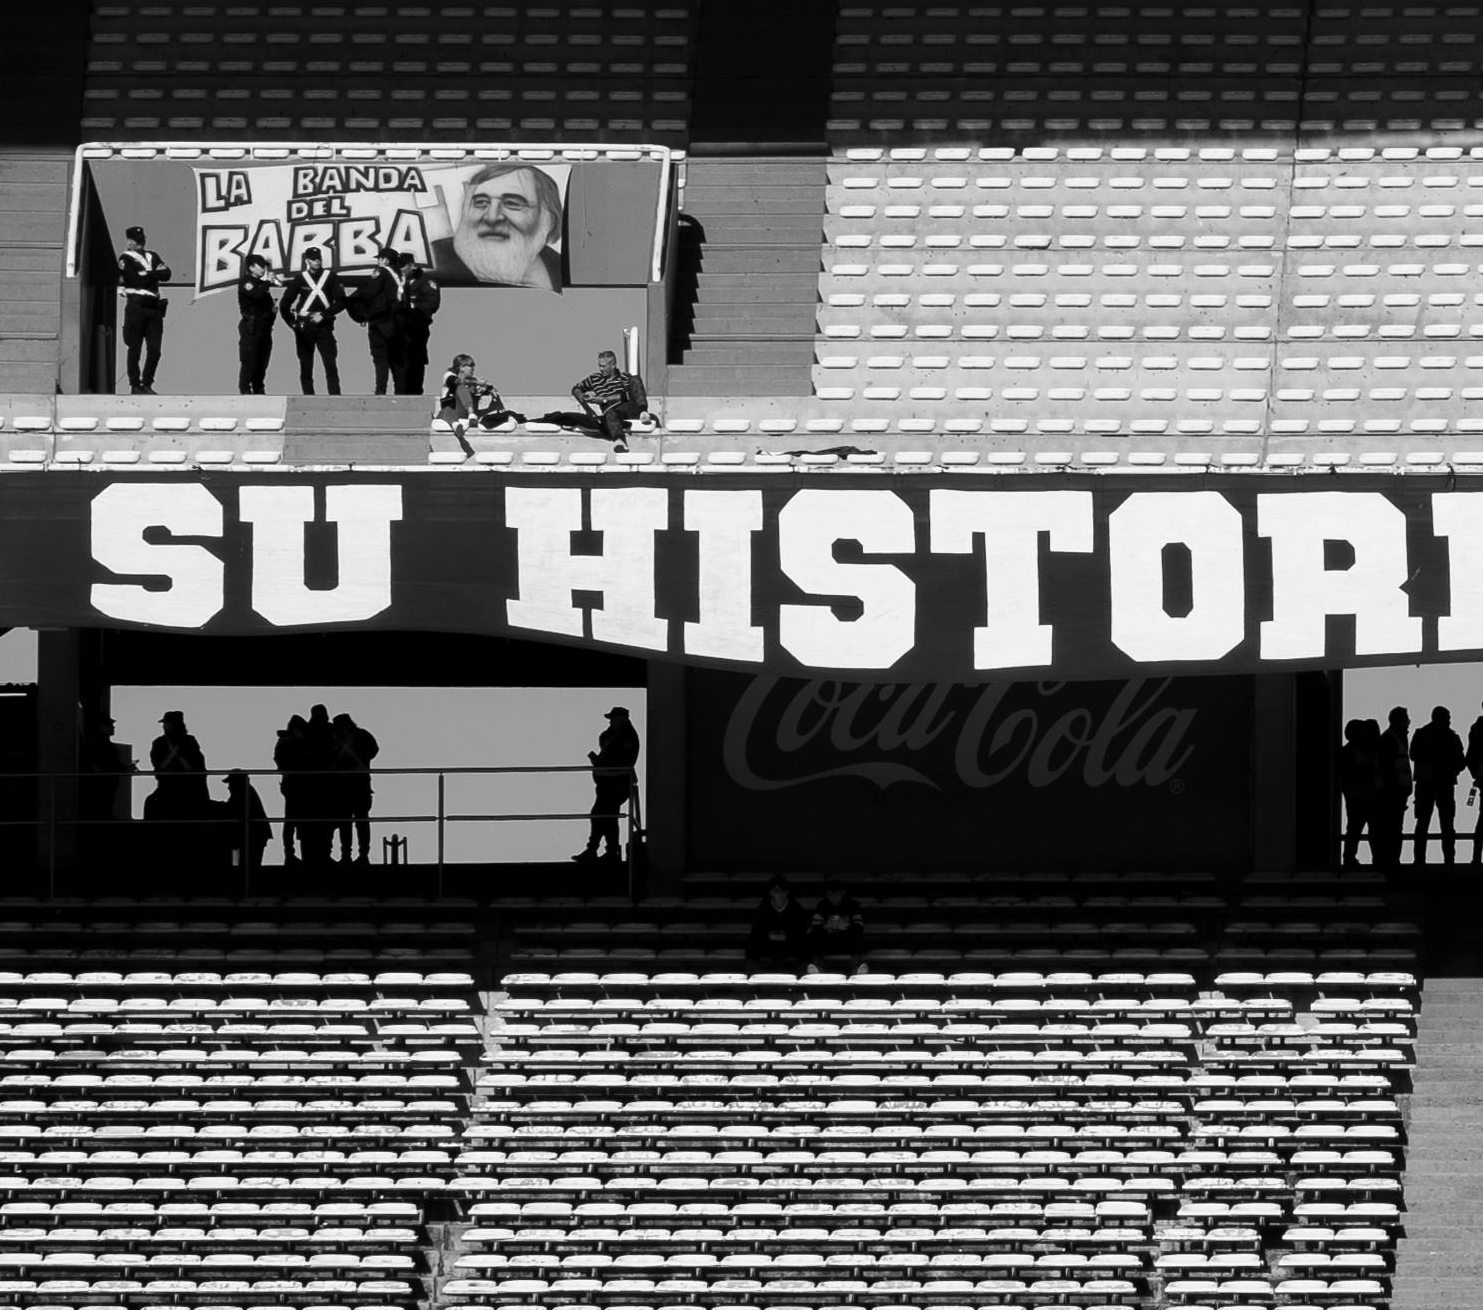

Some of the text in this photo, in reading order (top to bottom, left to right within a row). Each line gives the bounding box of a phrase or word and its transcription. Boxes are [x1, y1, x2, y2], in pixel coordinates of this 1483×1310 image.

[200, 166, 427, 213] LA BANDA
[287, 195, 351, 222] DEL
[201, 209, 433, 292] BARBA
[90, 482, 403, 628] SU
